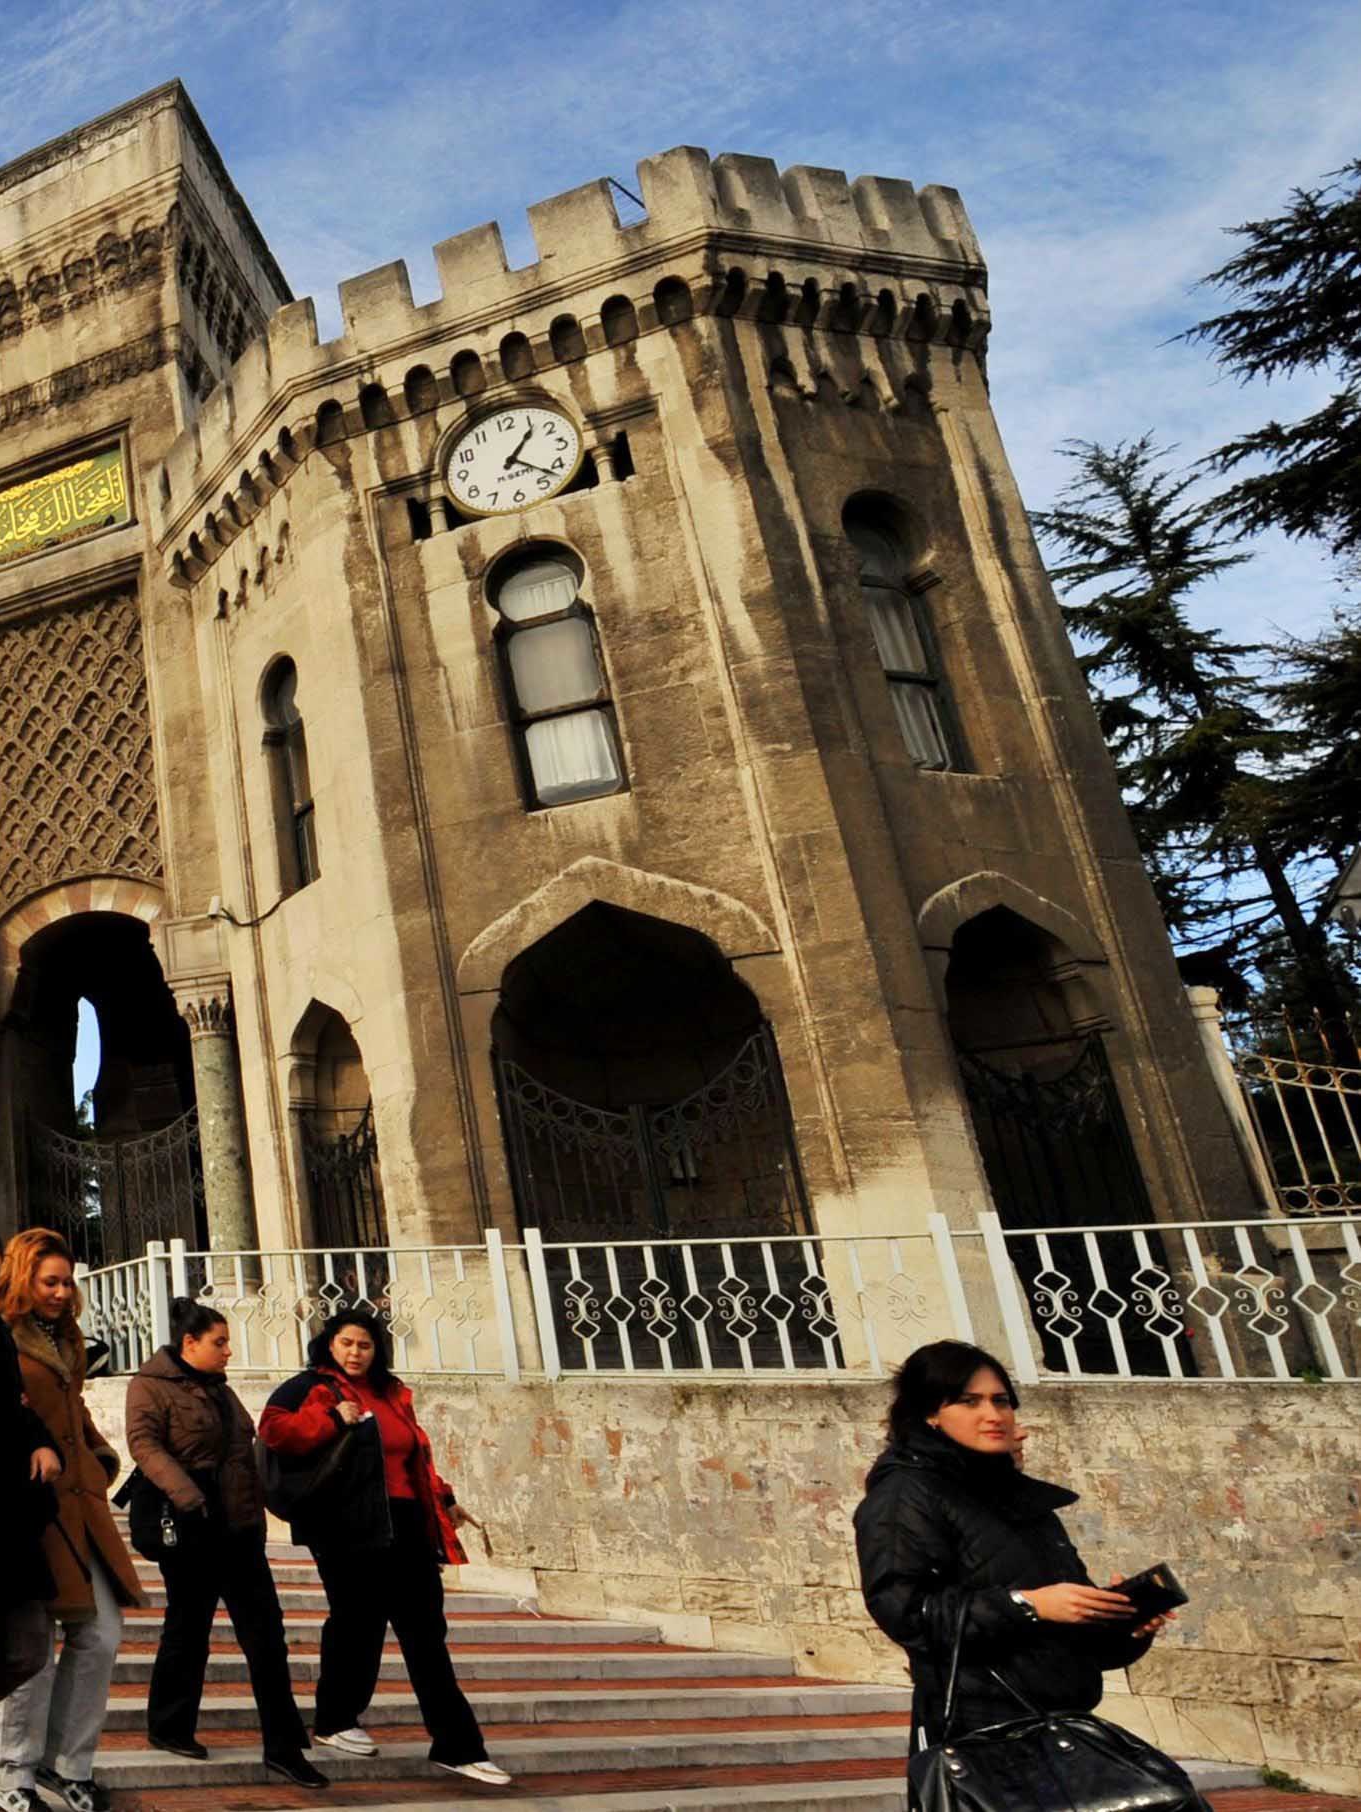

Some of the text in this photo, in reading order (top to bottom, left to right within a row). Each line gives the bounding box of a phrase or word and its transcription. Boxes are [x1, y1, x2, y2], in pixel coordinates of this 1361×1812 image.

[497, 416, 515, 432] 12
[543, 421, 556, 436] 2
[475, 431, 487, 445] 11
[555, 437, 568, 451] 3
[459, 448, 474, 464] 10
[551, 456, 565, 470] 4
[457, 469, 469, 482] 9
[537, 475, 551, 490] 5
[467, 485, 480, 499] 8
[486, 491, 499, 506] 7
[513, 488, 526, 503] 6
